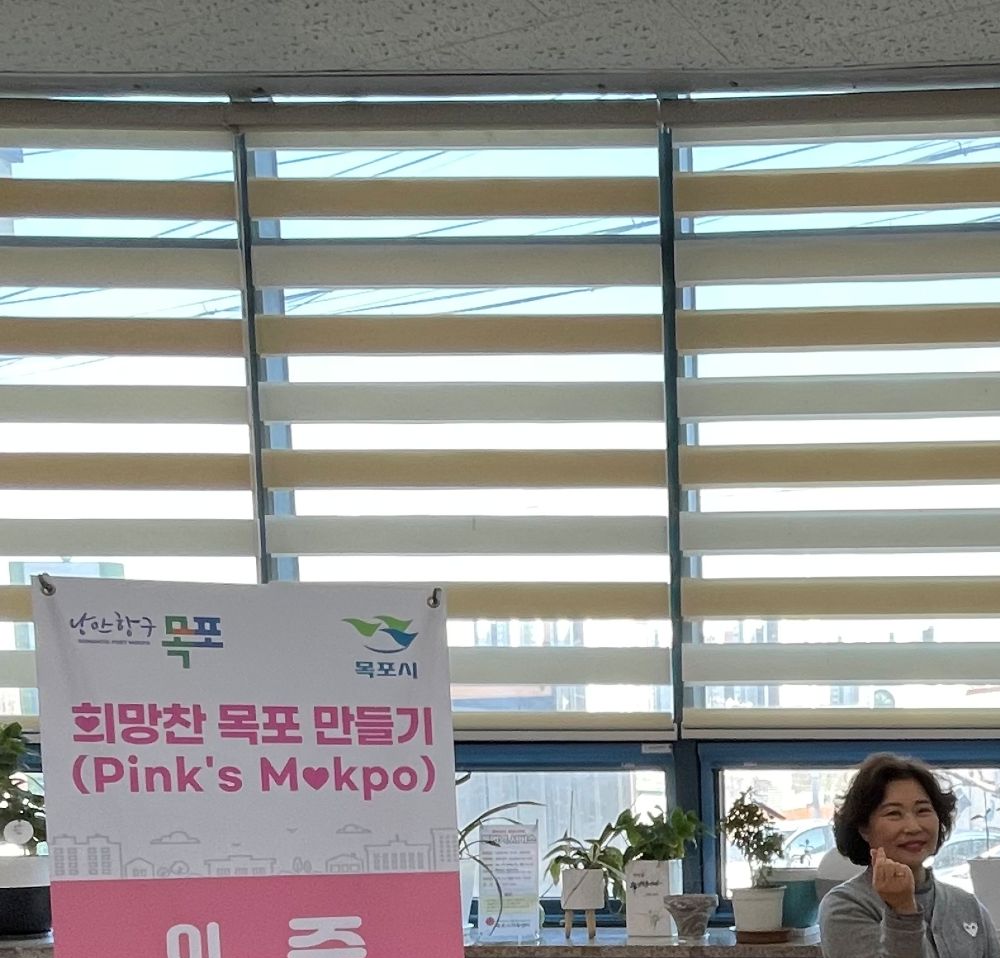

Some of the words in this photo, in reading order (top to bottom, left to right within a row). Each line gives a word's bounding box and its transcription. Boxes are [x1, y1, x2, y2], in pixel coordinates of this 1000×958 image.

[162, 616, 223, 668] 목포
[355, 660, 418, 680] 목포시
[71, 702, 206, 746] 희망찬
[218, 704, 302, 745] 목포
[313, 705, 433, 746] 만들기
[72, 754, 242, 794] (Pink's
